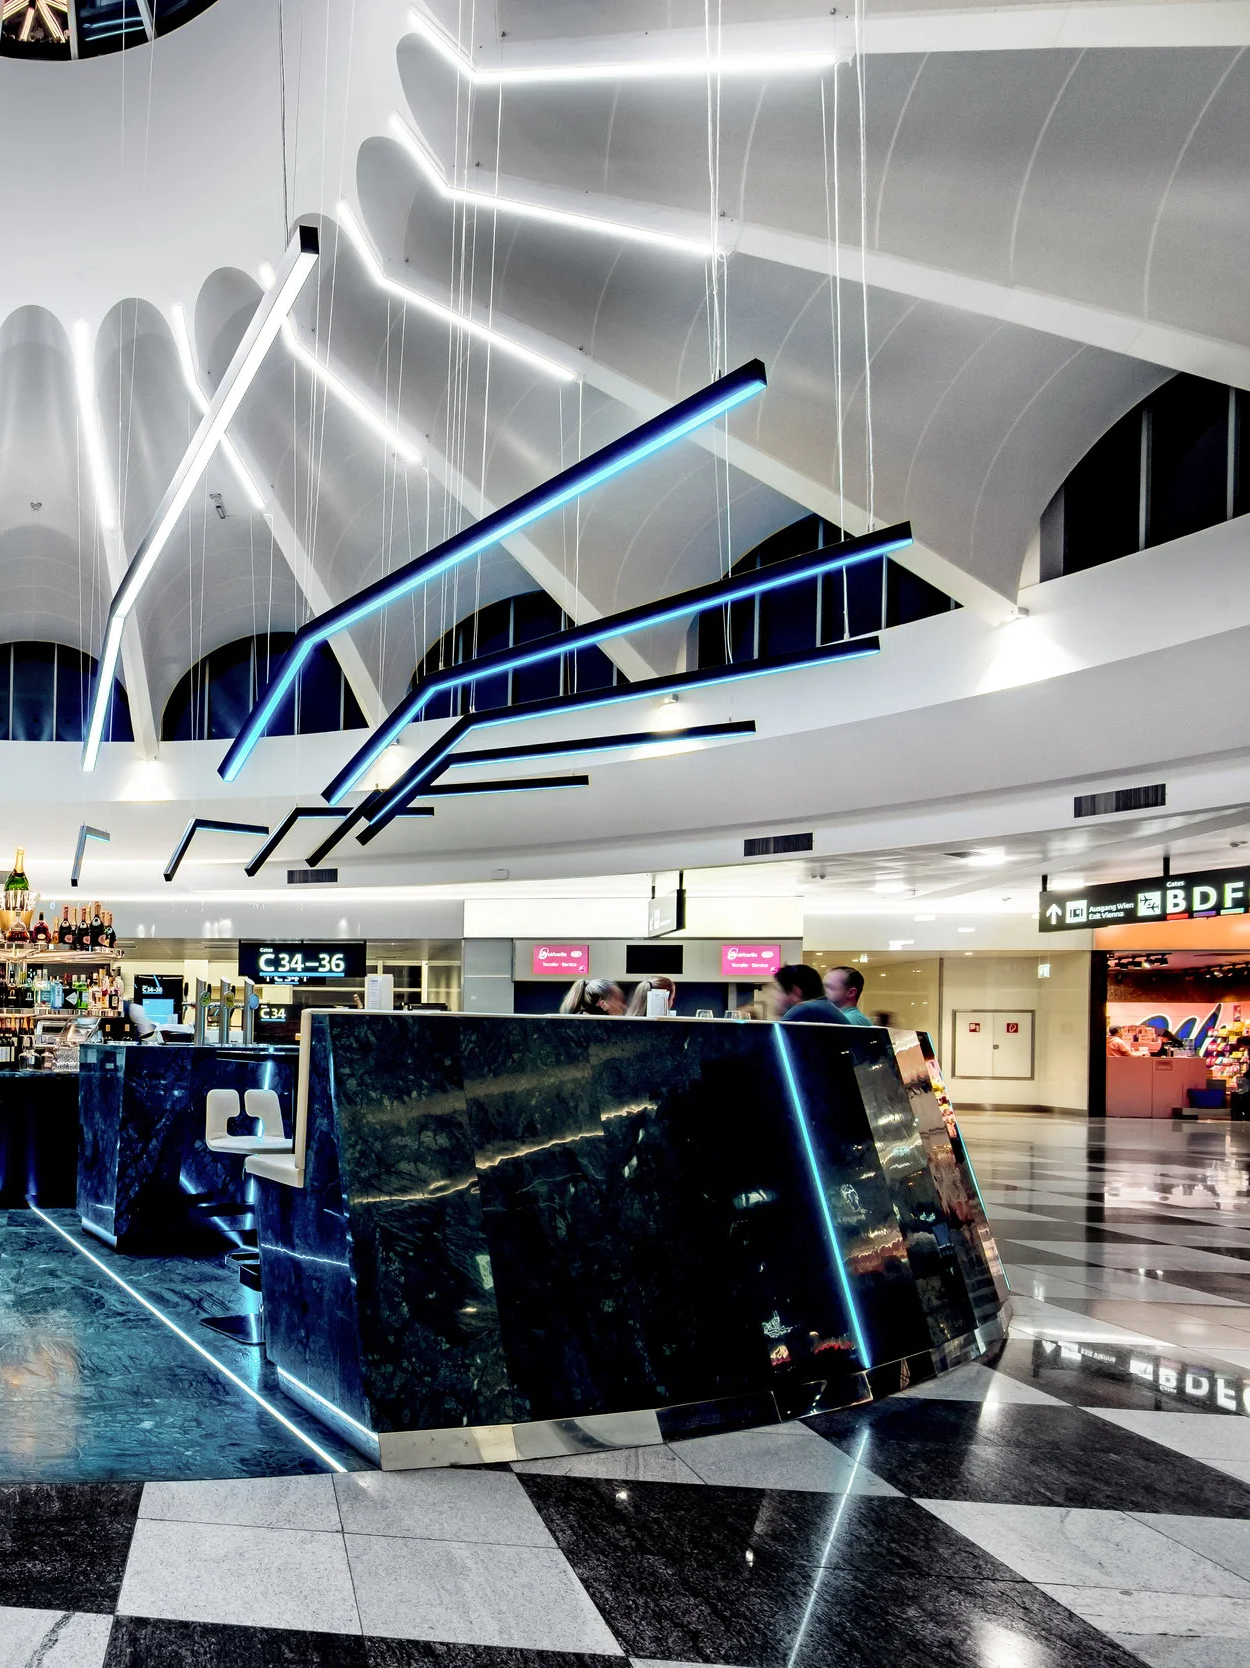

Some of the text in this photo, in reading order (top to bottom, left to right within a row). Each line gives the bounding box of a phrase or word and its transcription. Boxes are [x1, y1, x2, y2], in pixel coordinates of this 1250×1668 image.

[1166, 881, 1244, 914] B D F
[1088, 902, 1135, 913] Ausgang Wien
[1088, 911, 1124, 920] Exit Vienna
[259, 953, 275, 972] C
[260, 1008, 286, 1019] C 34
